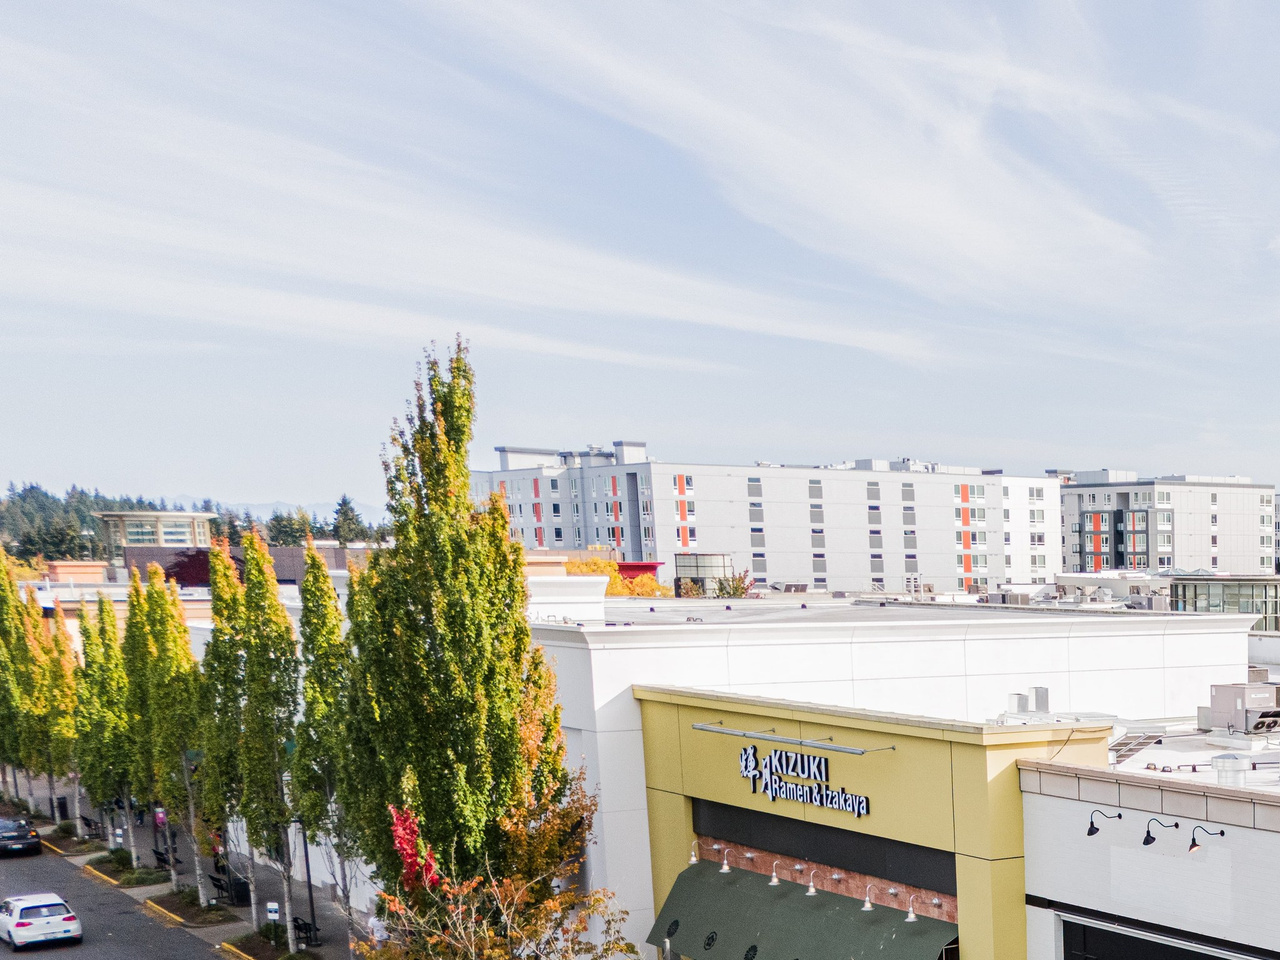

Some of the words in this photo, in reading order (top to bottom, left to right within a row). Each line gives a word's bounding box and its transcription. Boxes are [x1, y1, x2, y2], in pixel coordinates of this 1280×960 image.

[771, 750, 827, 781] KIZUKI
[772, 775, 811, 803] Ramen
[812, 782, 821, 806] &
[823, 785, 868, 817] Izakaya
